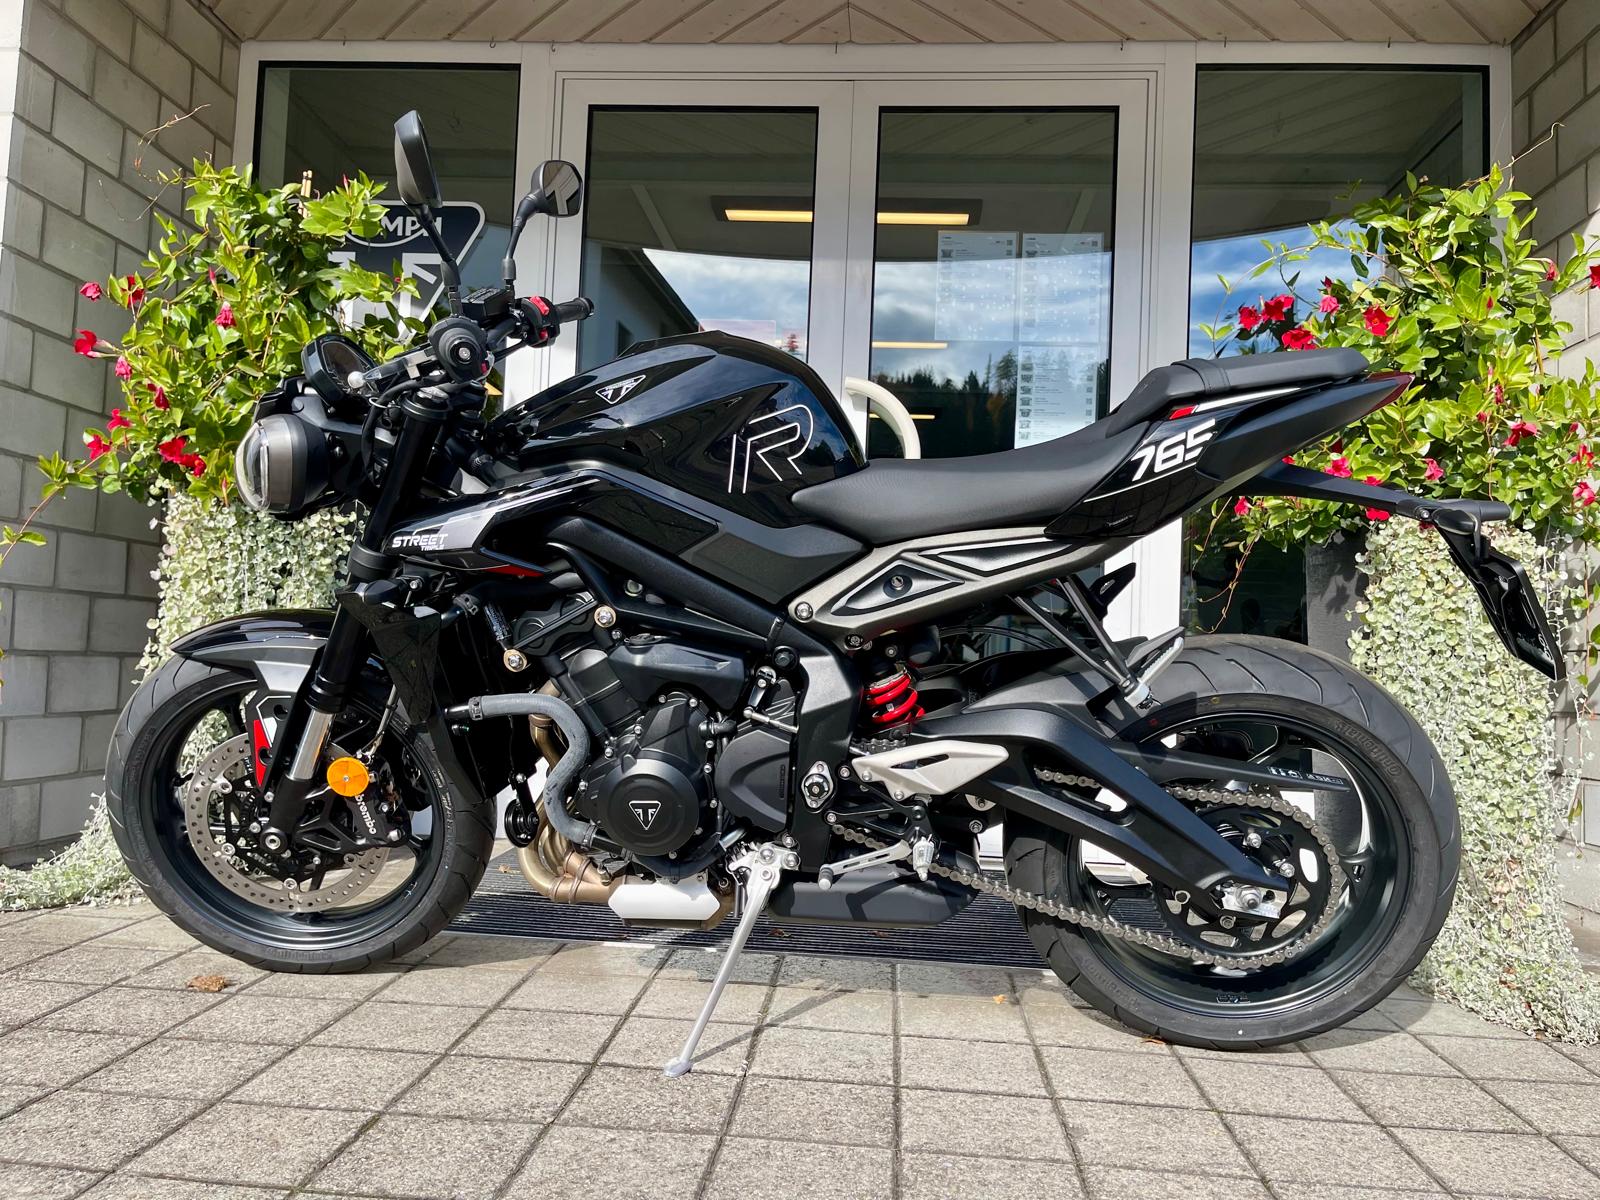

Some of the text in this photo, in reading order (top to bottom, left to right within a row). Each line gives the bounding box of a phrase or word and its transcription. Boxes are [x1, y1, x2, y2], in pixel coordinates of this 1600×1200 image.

[728, 404, 813, 494] R
[1130, 419, 1216, 482] 765
[392, 533, 449, 548] STREET
[355, 793, 377, 835] brembo
